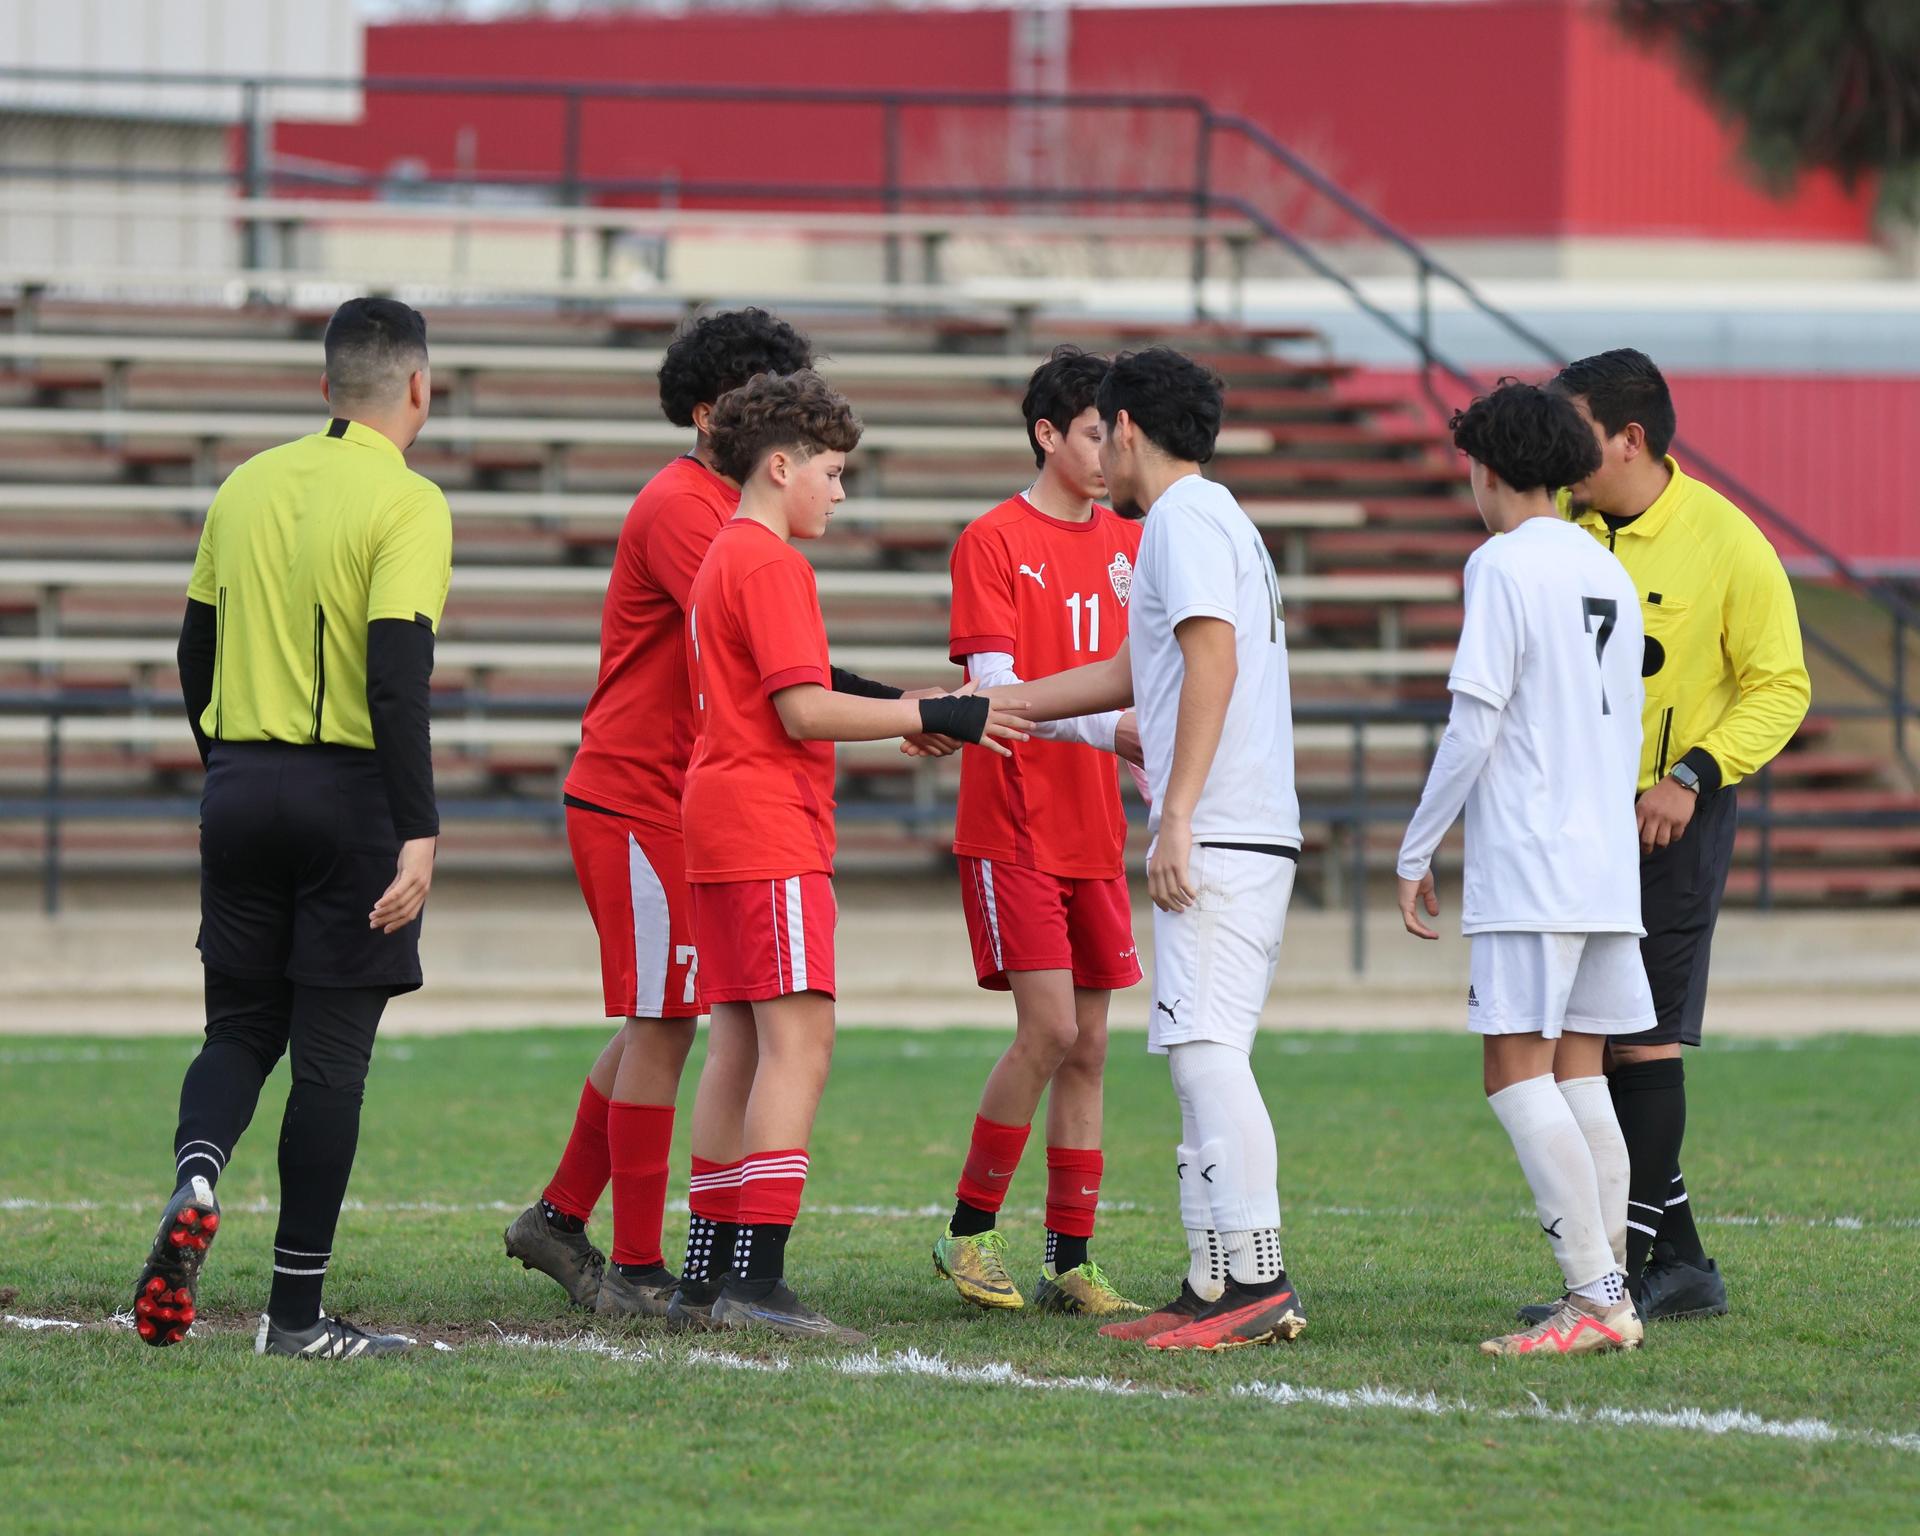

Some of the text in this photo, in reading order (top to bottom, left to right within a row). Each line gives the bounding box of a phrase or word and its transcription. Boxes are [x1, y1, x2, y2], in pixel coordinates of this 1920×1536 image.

[1065, 591, 1100, 652] 11
[1581, 595, 1618, 715] 7
[675, 944, 699, 1004] 7
